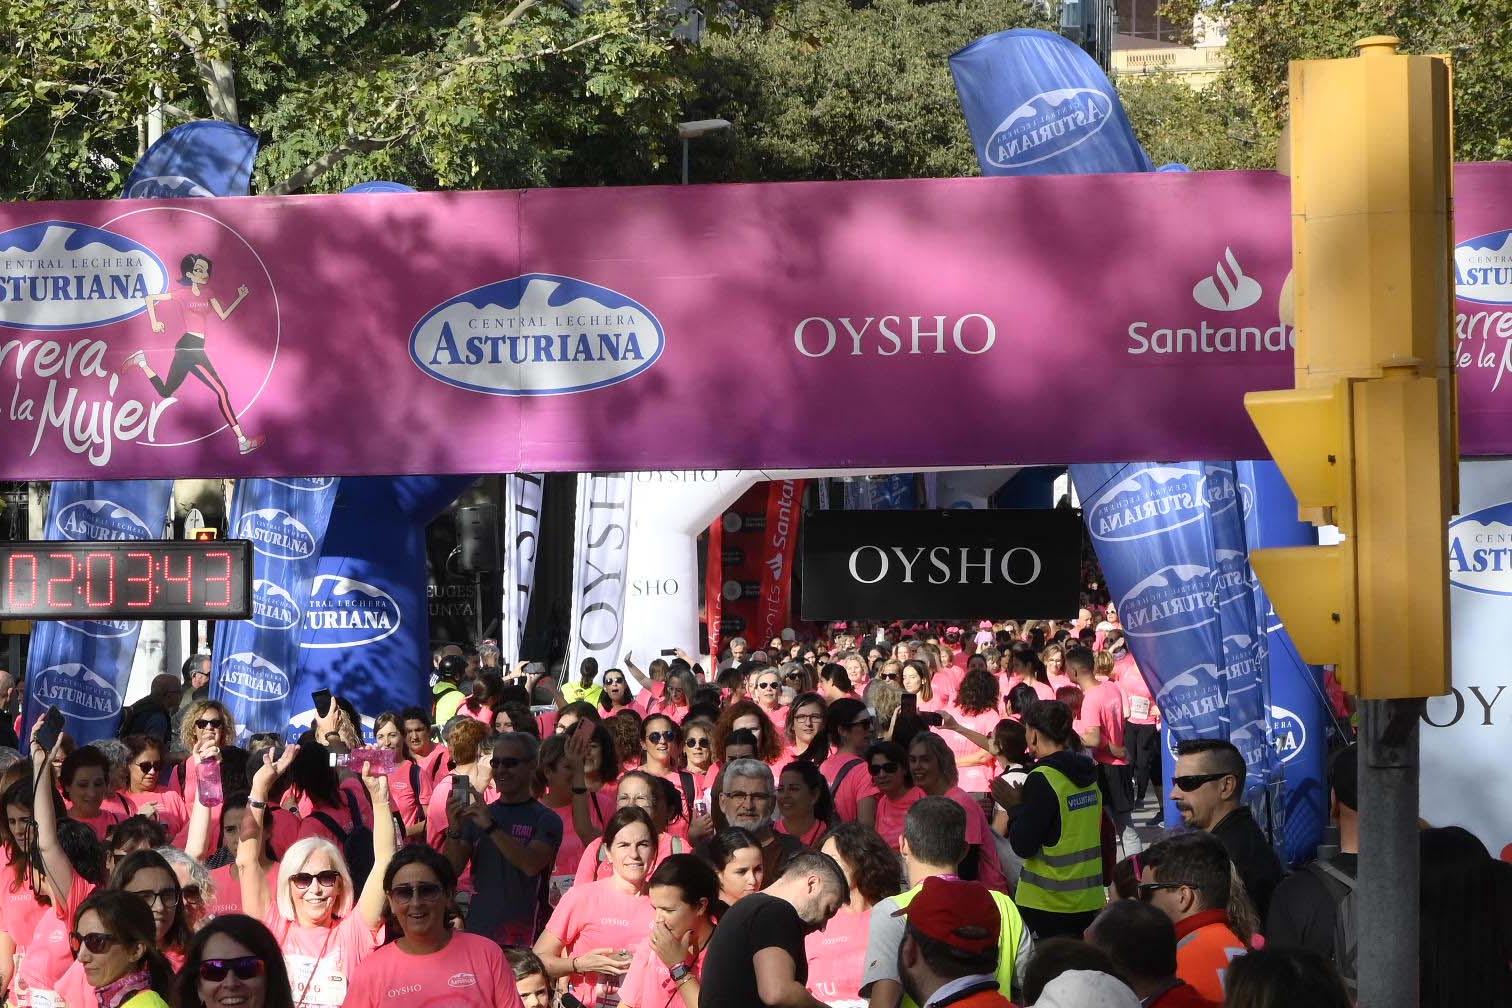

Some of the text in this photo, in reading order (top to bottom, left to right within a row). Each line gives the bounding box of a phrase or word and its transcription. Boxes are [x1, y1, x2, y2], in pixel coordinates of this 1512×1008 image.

[72, 256, 143, 268] LECHERA
[468, 314, 637, 329] CENTRAL LECHERA
[795, 313, 997, 357] OYSHO
[429, 320, 644, 366] ASTURIANA
[1128, 320, 1296, 354] Santand
[1477, 342, 1496, 368] la
[10, 381, 34, 422] la
[29, 374, 179, 467] Mujer
[240, 520, 308, 554] ASTURIANA
[578, 472, 631, 652] OYSH
[848, 545, 1042, 586] OYSHO
[8, 552, 233, 607] 02:03:43
[632, 577, 679, 596] SHO
[253, 602, 293, 624] URIANA
[310, 600, 334, 608] TRAL
[304, 610, 392, 630] URIANA
[37, 677, 114, 713] ASTURIANA
[388, 984, 422, 998] OYSHO
[816, 981, 836, 997] TU
